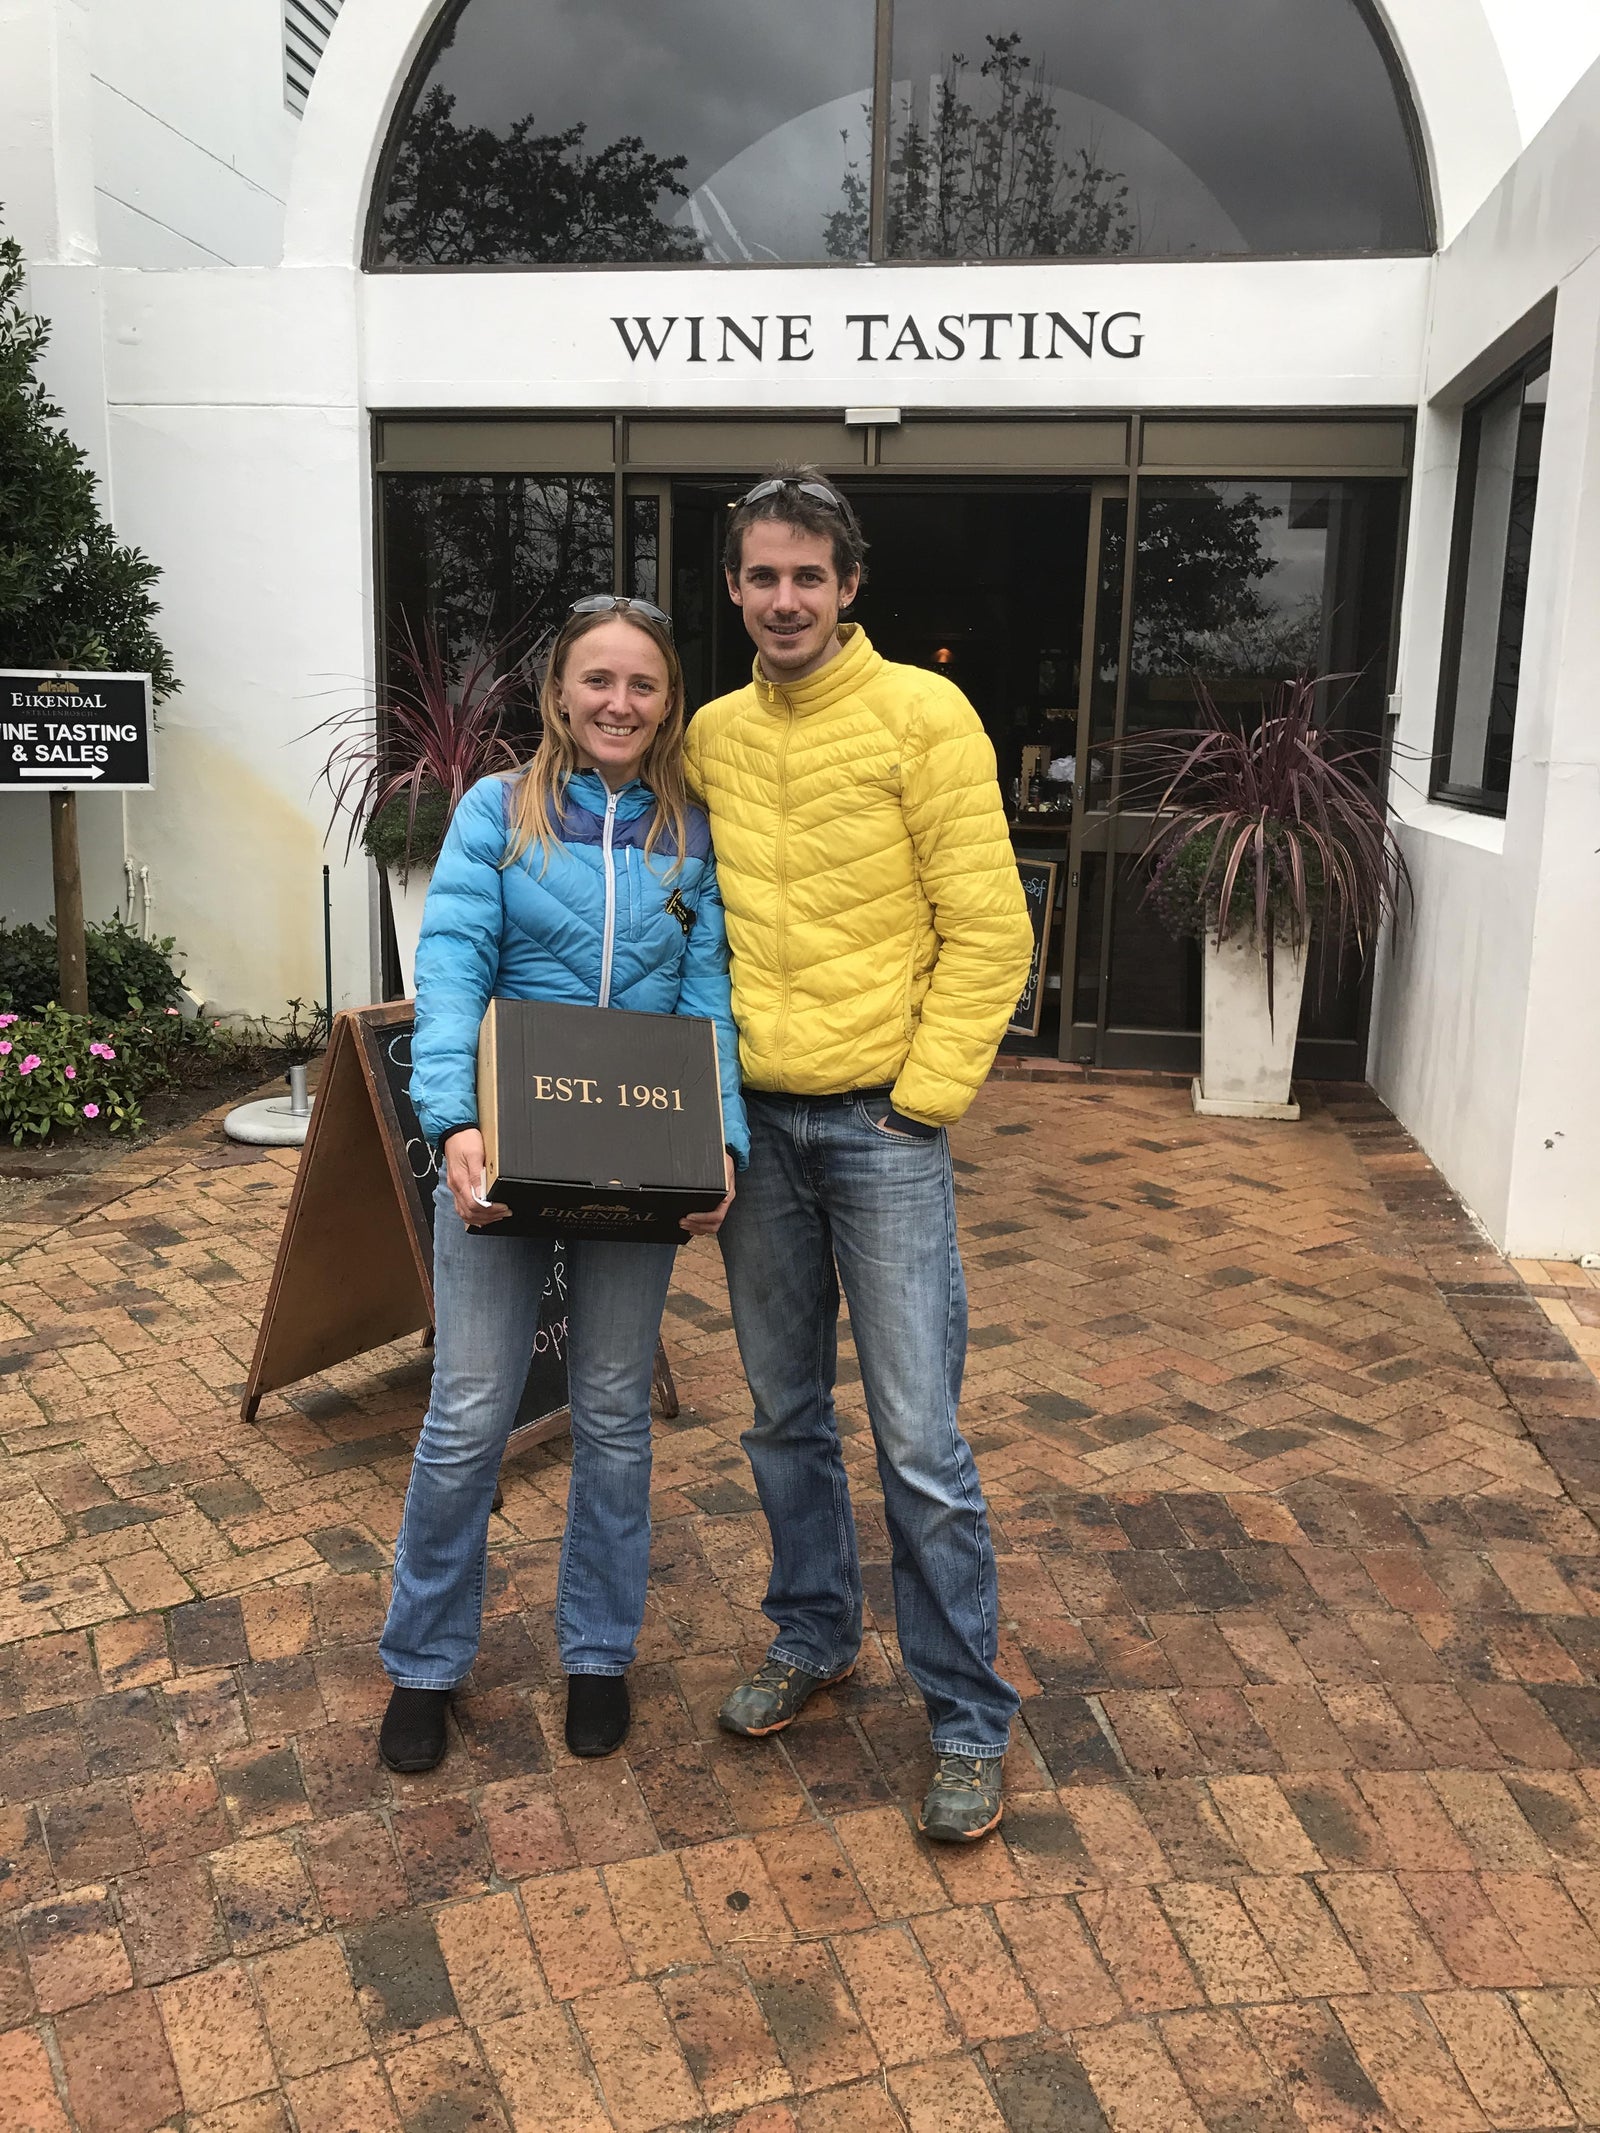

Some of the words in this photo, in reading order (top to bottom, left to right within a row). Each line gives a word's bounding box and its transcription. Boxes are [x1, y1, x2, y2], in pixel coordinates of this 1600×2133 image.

[610, 314, 814, 363] WINE
[845, 311, 1145, 362] TASTING
[11, 692, 107, 709] EIKENDAL
[0, 723, 38, 741] INE
[44, 724, 137, 742] TASTING
[12, 744, 28, 762] &
[35, 745, 109, 762] SALES
[532, 1075, 603, 1104] EST.
[617, 1084, 685, 1112] 1981
[538, 1206, 657, 1222] EIKENDAL
